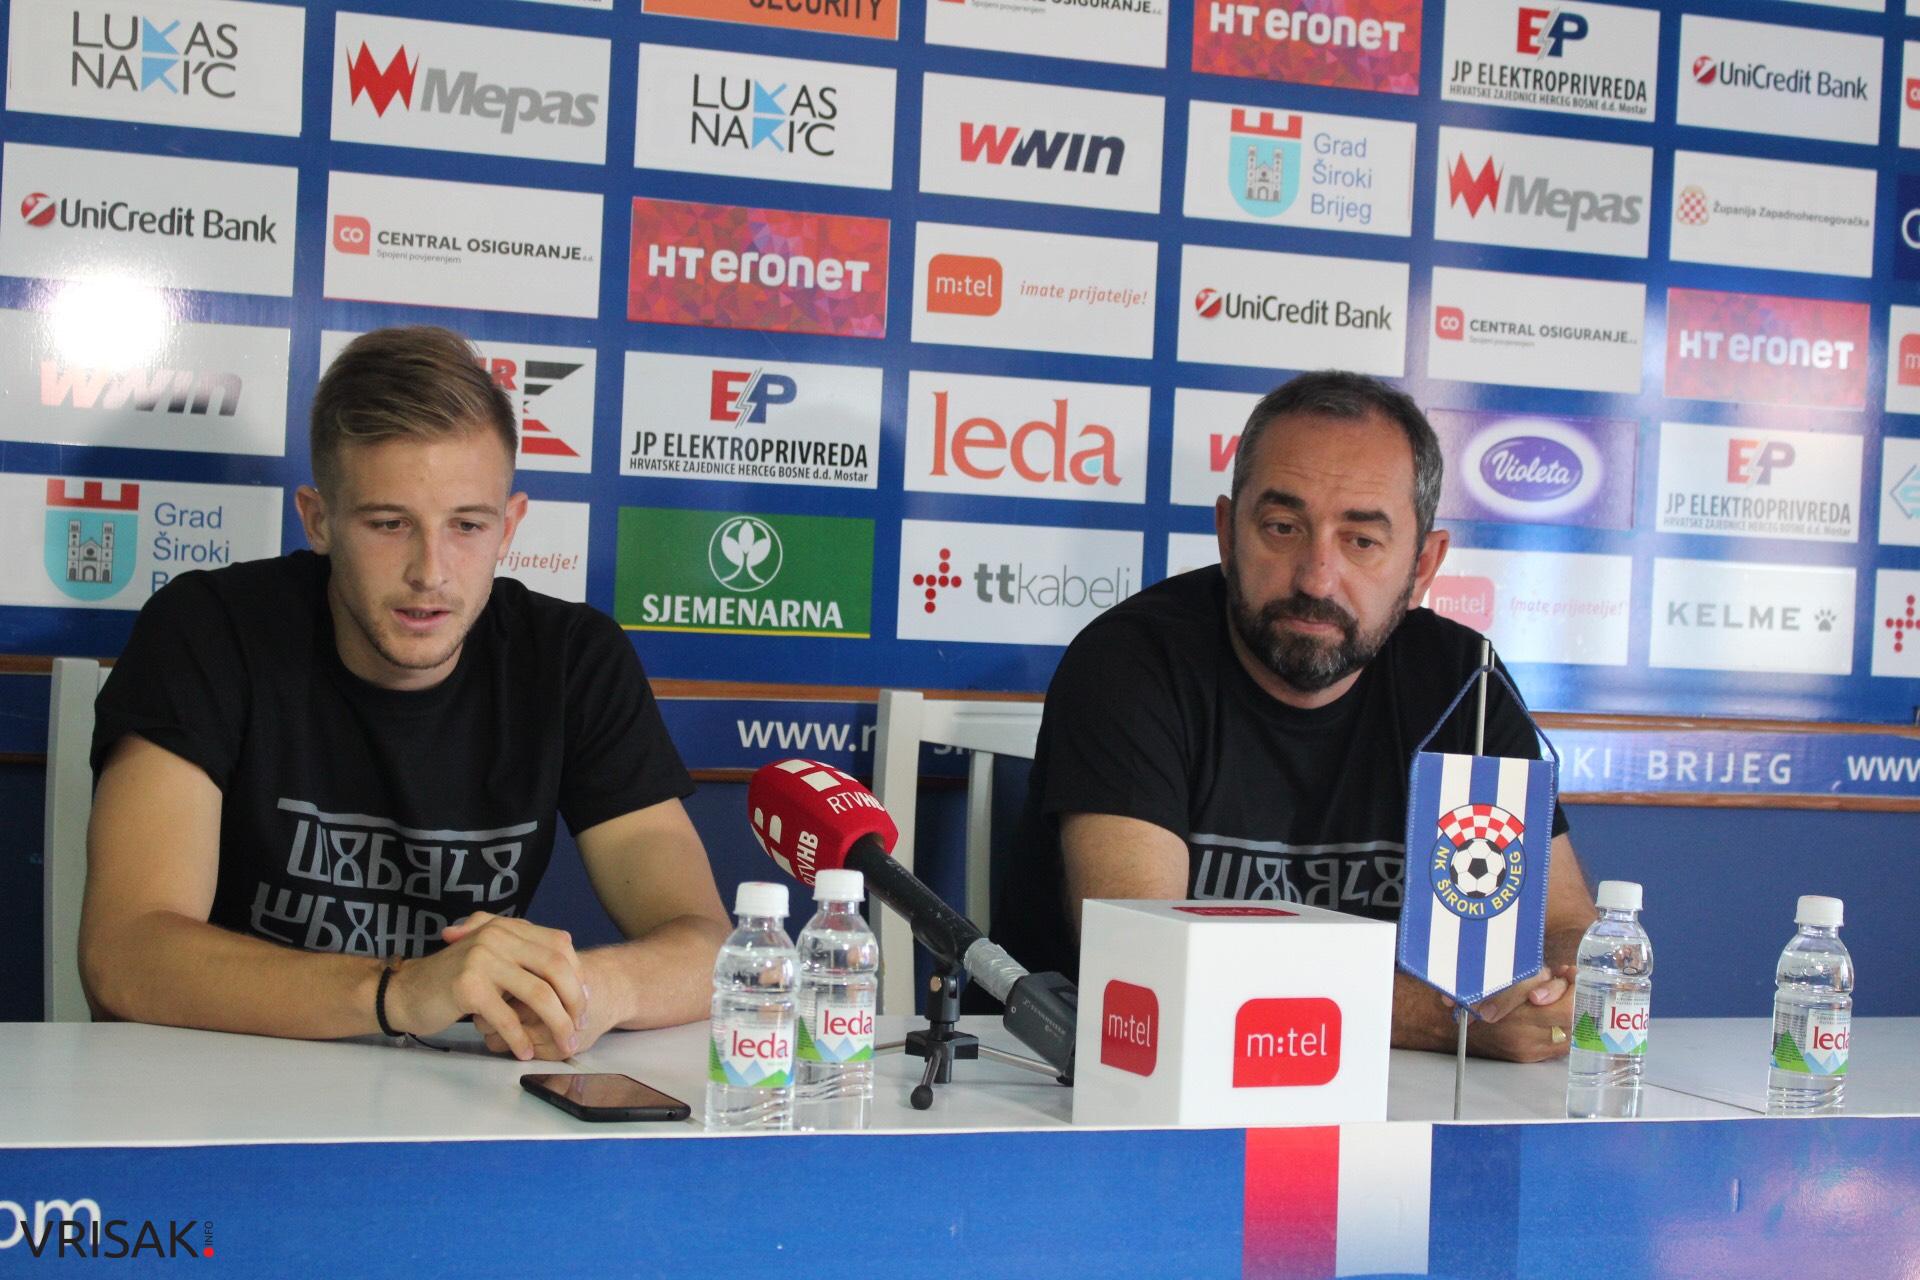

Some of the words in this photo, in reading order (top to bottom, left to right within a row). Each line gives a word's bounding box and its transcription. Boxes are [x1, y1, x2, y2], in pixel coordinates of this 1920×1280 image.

[1051, 0, 1151, 13] GURANJE
[1209, 1, 1260, 35] HT
[1451, 60, 1472, 82] JP
[1478, 63, 1647, 102] ELEKTROPRIVREDA
[1720, 61, 1812, 95] UniCredit
[1817, 71, 1868, 100] Bank
[420, 67, 599, 134] Mepas
[1450, 85, 1492, 99] HRVATSKE
[1493, 90, 1537, 104] ZAJEDNICE
[1539, 94, 1571, 107] HERCEG
[1573, 98, 1599, 110] BOSNE
[1619, 103, 1647, 115] Mostar
[1313, 132, 1367, 158] Grad
[1312, 160, 1373, 189] Široki
[1310, 194, 1372, 225] Brijeg
[1504, 174, 1643, 232] Mepas
[60, 197, 195, 237] UniCredit
[203, 208, 277, 244] Bank
[377, 230, 462, 251] CENTRAL
[467, 237, 582, 261] OSIGURANJE
[649, 243, 704, 280] HT
[935, 274, 993, 298] m:tel
[1020, 280, 1065, 298] imate
[1069, 285, 1148, 308] prijatelje!
[1225, 292, 1329, 326] UniCredit
[1335, 300, 1392, 330] Bank
[1469, 318, 1535, 337] CENTRAL
[1539, 324, 1629, 344] OSIGURANJE
[1679, 330, 1724, 360] HT
[631, 431, 657, 456] JP
[663, 432, 868, 468] ELEKTROPRIVREDA
[929, 390, 1122, 486] leda
[630, 458, 681, 472] HRVATSKE
[683, 460, 736, 475] ZAJEDNICE
[738, 464, 776, 478] HERCEG
[778, 466, 811, 479] BOSNE
[813, 468, 832, 481] d.d.
[834, 469, 868, 482] Mostar
[1492, 450, 1570, 484] Violeta
[154, 502, 222, 529] Grad
[1665, 492, 1685, 514] JP
[1690, 494, 1850, 524] ELEKTROPRIVREDA
[152, 532, 230, 563] Široki
[500, 551, 578, 573] rijatelje!
[642, 593, 843, 629] SJEMENARNA
[1435, 593, 1486, 614] m:tel
[1666, 602, 1802, 631] KELME
[1648, 750, 1792, 786] BRIJEG
[1434, 846, 1450, 870] NK
[1491, 851, 1522, 910] BRIJEG
[1437, 878, 1485, 915] ŠIROKI
[823, 1009, 873, 1036] leda
[1108, 1014, 1151, 1048] m:tel
[731, 1030, 789, 1059] leda
[1246, 1023, 1328, 1058] m:tel
